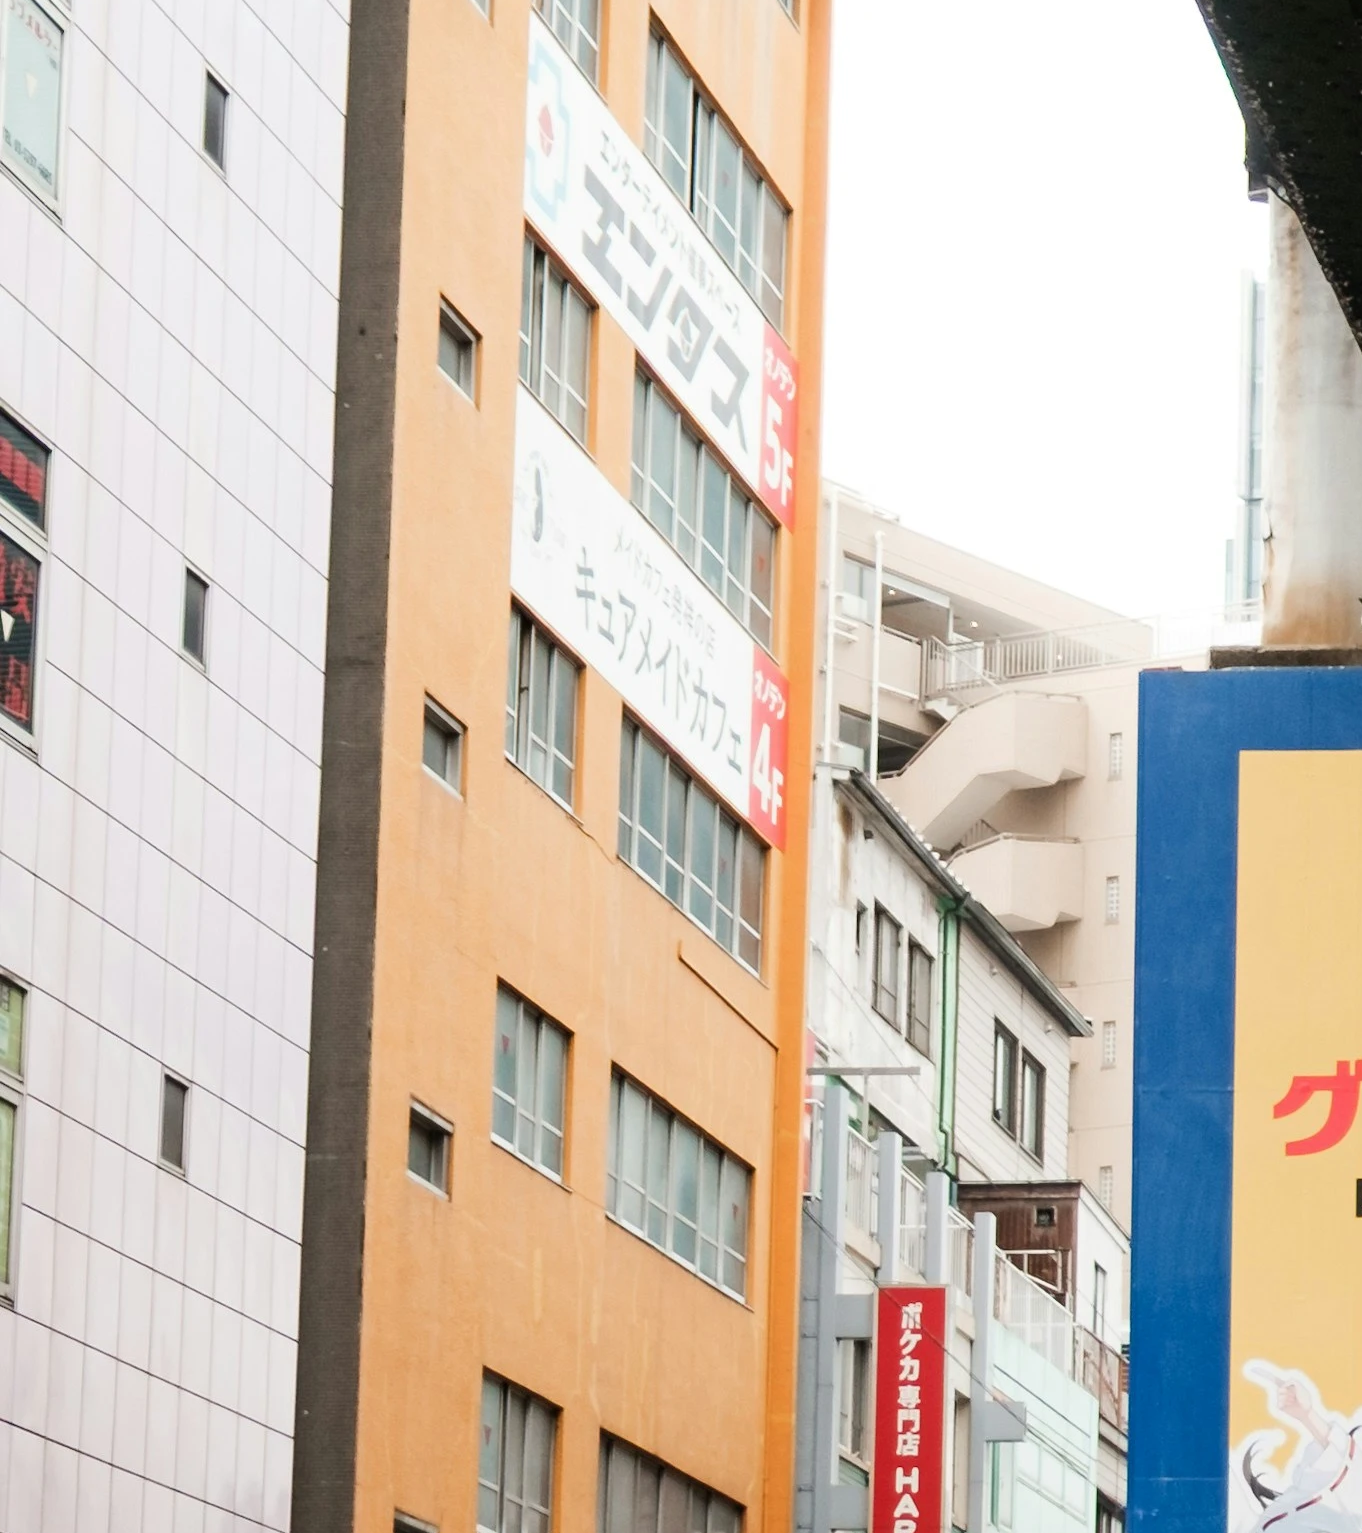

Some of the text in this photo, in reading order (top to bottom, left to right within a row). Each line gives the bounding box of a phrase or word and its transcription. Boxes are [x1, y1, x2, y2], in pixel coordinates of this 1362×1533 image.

[581, 163, 750, 455] エンタス
[764, 347, 796, 401] オノデン
[764, 394, 794, 508] 5F
[575, 546, 743, 776] キュアメイドカフェ
[753, 668, 787, 721] オノデン
[752, 722, 783, 826] 4F
[896, 1301, 924, 1457] ポケカ専門店
